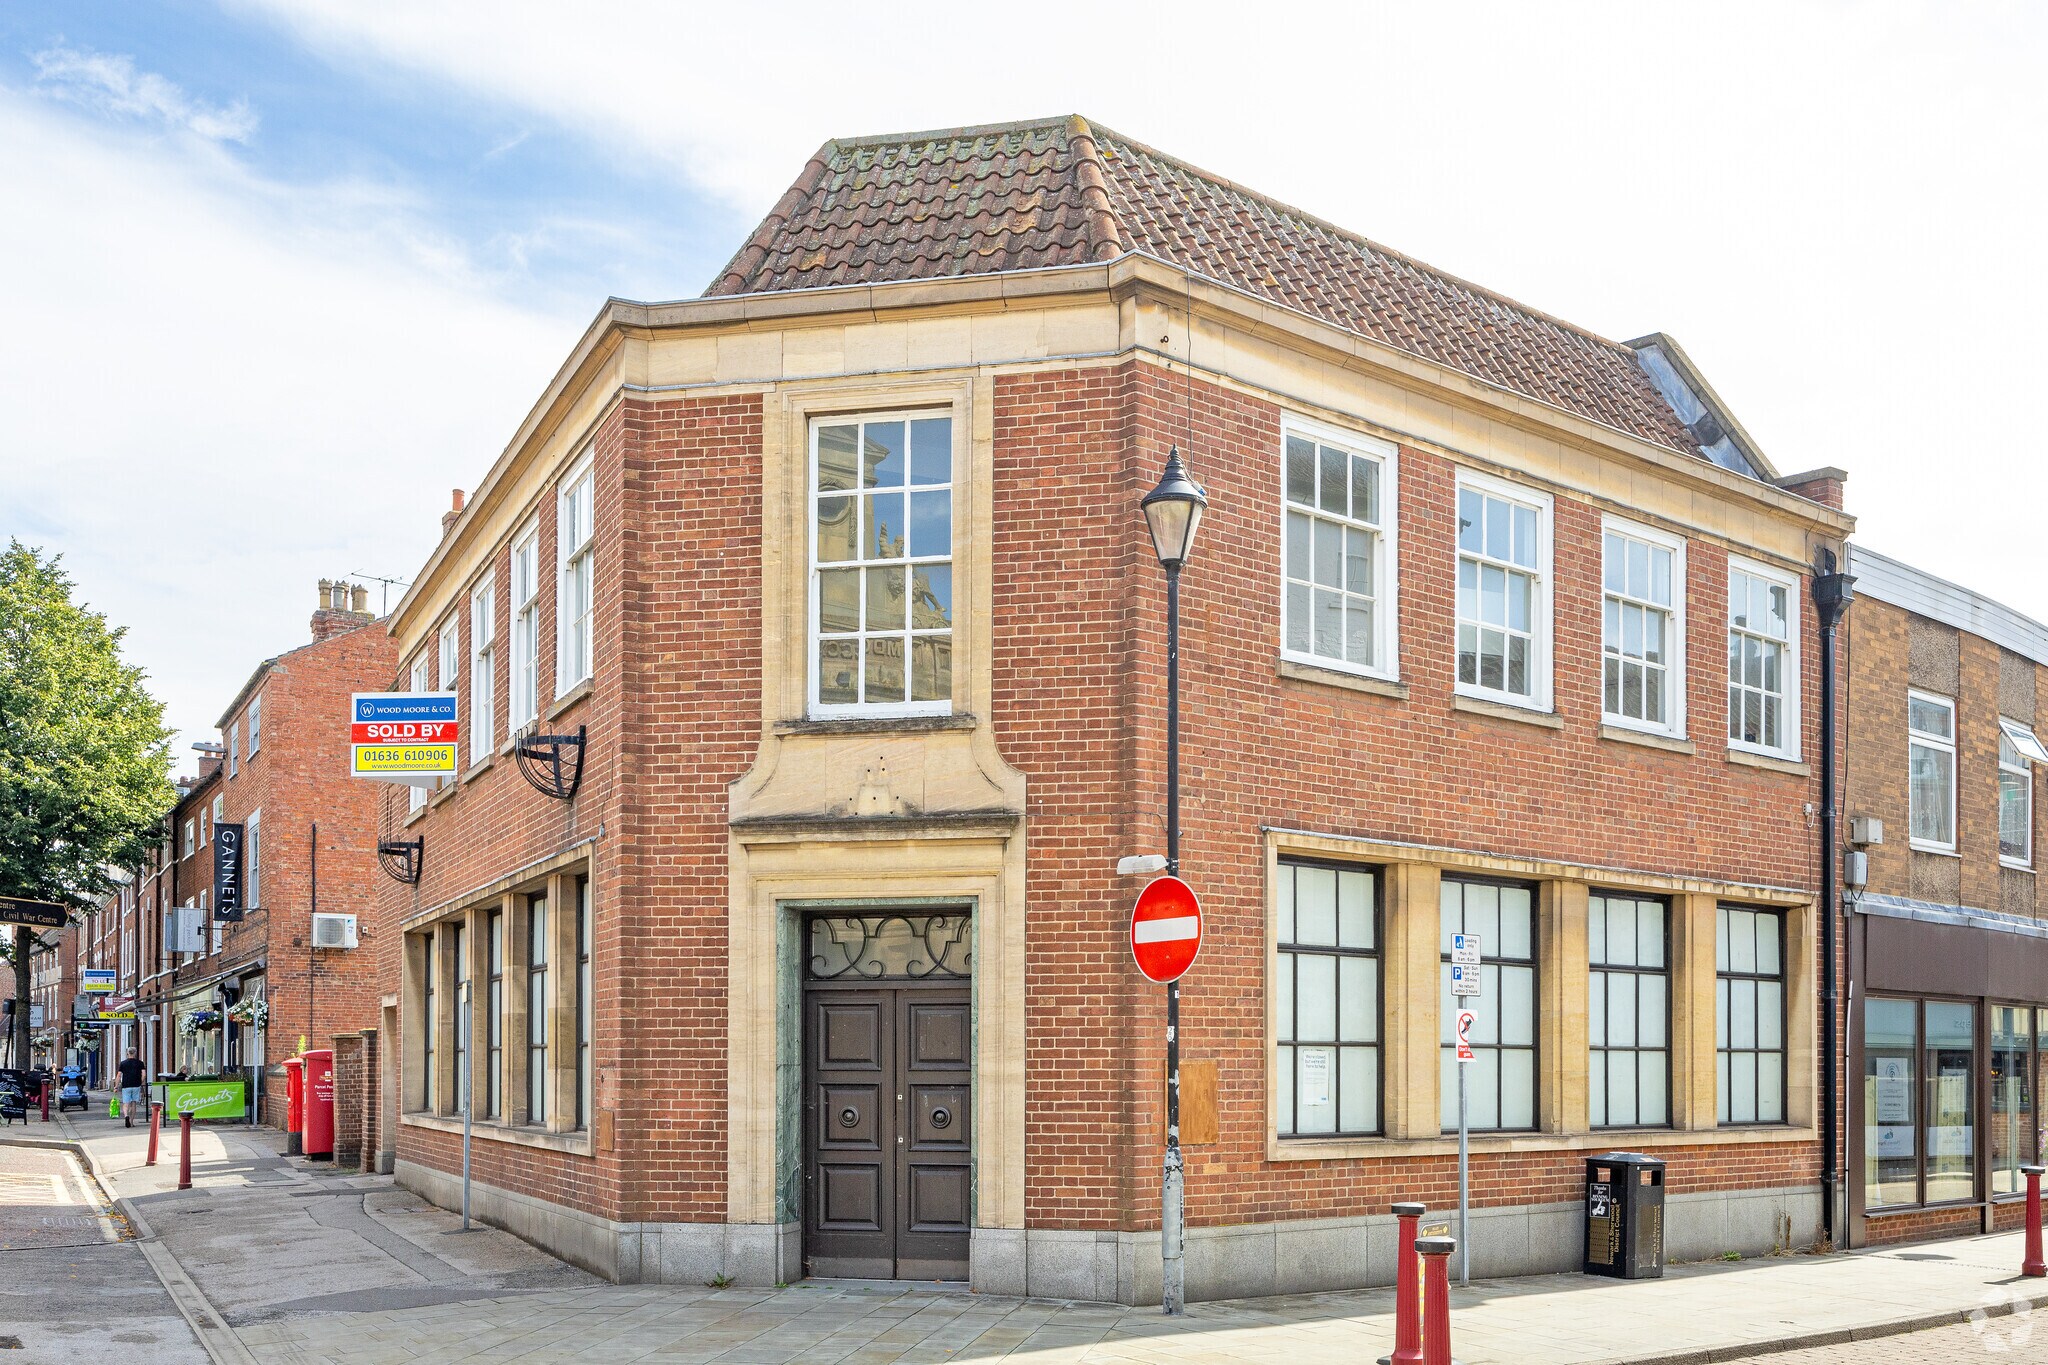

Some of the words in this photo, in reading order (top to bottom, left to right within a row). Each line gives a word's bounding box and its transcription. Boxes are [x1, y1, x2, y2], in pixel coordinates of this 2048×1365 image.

[367, 724, 416, 738] SOLD
[421, 724, 445, 737] BY
[364, 750, 400, 762] 01636
[404, 750, 448, 760] 610906
[221, 830, 236, 914] GANNETS
[3, 911, 19, 920] Civil
[22, 913, 35, 922] War
[37, 915, 58, 924] Centre
[176, 1088, 238, 1112] Gannets
